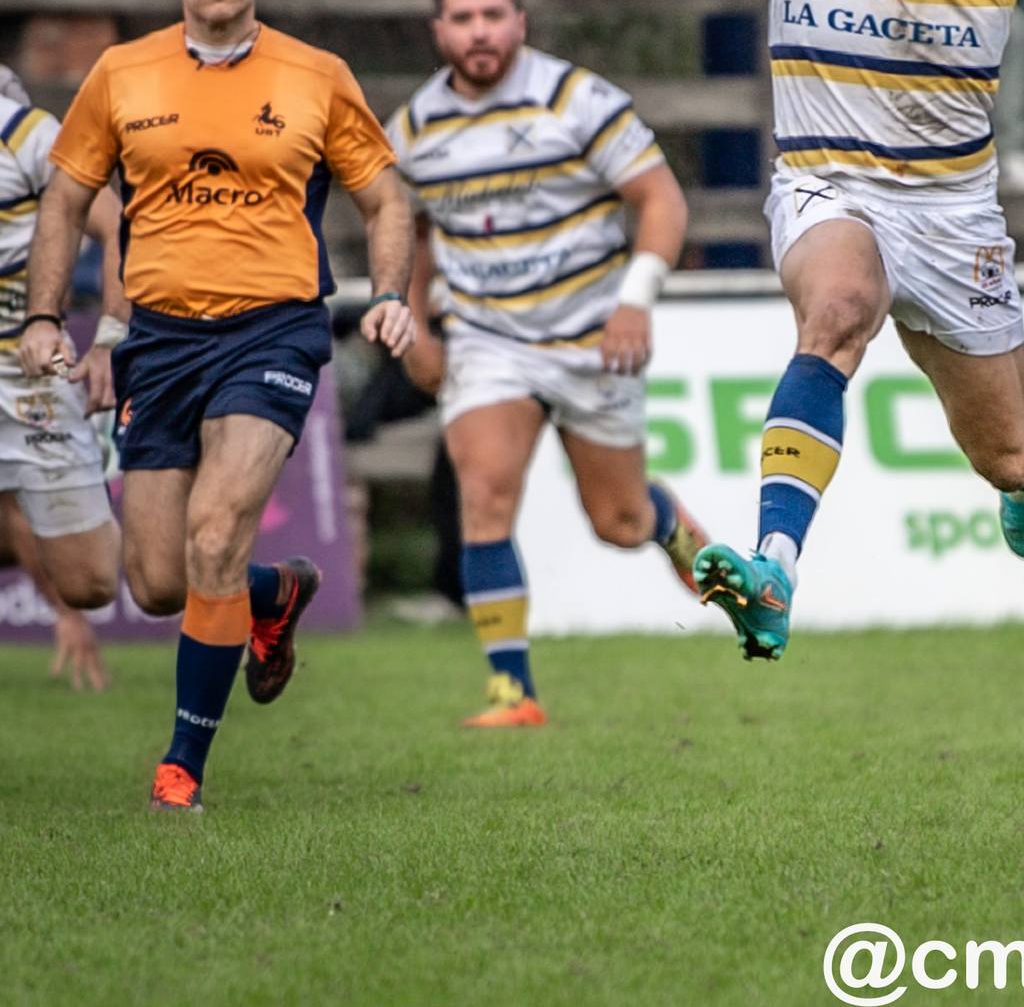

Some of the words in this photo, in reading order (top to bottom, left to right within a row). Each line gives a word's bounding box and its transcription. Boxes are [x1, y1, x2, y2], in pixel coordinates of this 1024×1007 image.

[784, 0, 818, 28] LA
[827, 8, 981, 48] GACETA
[126, 113, 180, 134] PROCER
[165, 180, 265, 206] Macro
